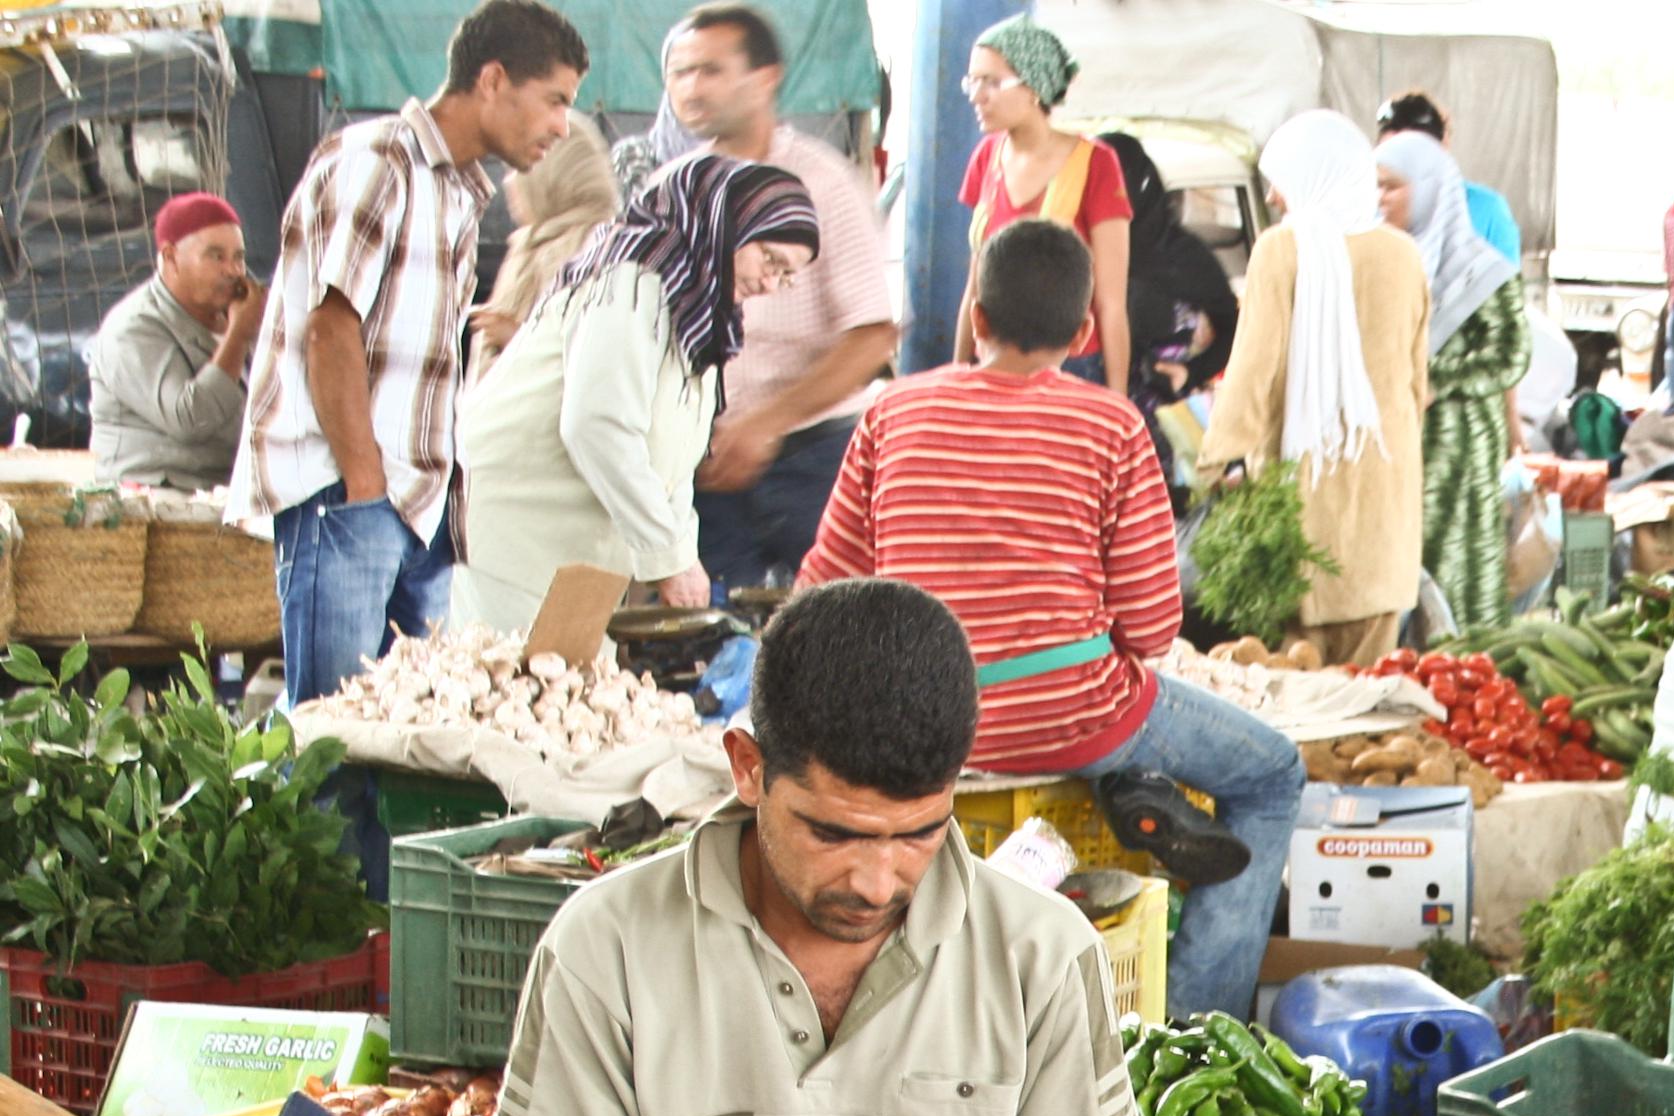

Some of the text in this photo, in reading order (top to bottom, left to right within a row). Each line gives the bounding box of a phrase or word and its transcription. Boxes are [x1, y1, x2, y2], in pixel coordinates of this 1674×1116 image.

[1324, 839, 1427, 857] coopaman
[201, 1032, 336, 1061] FRESH GARLIC
